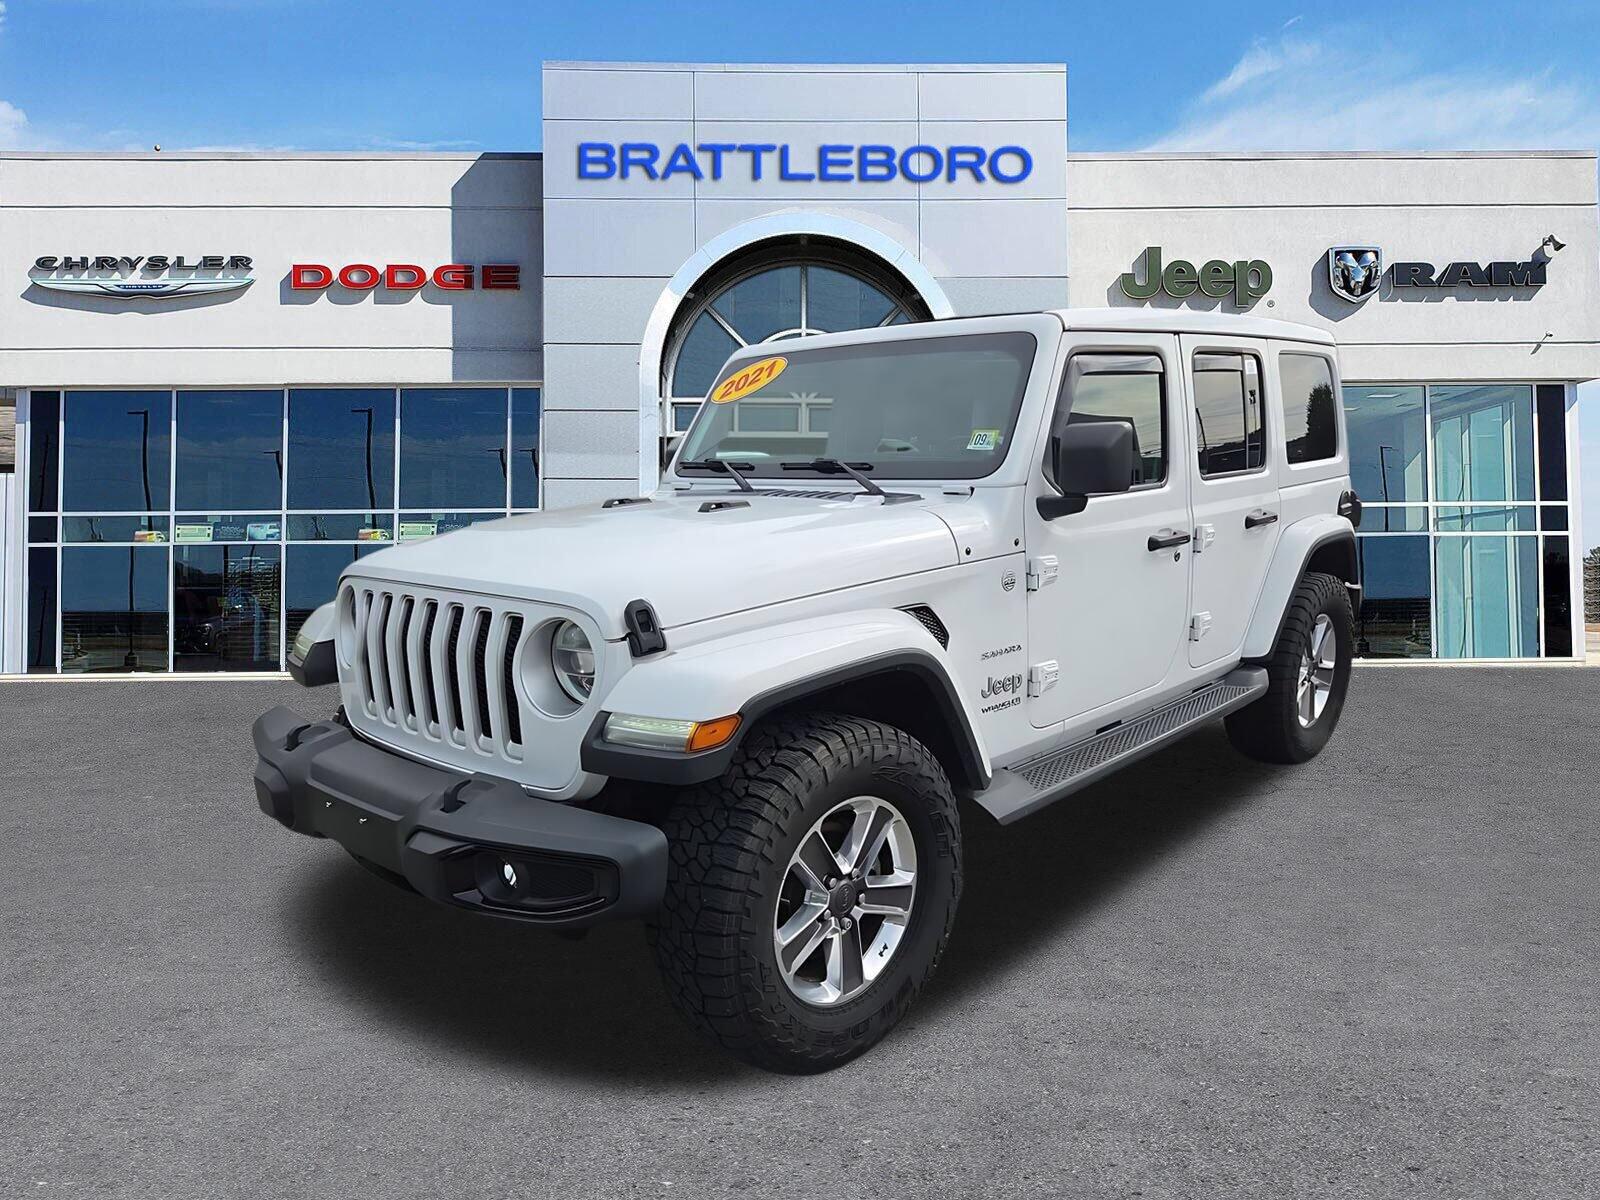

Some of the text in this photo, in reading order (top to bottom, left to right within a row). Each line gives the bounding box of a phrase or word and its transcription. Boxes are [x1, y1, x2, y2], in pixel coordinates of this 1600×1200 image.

[577, 142, 1033, 183] BRATTLEBORO
[33, 254, 254, 271] CHRYSLER
[1392, 261, 1548, 287] RAM
[290, 263, 521, 291] DODGE
[1121, 246, 1273, 308] Jeep
[719, 359, 778, 401] 2021
[973, 433, 988, 446] 09
[980, 673, 1023, 699] Jeep
